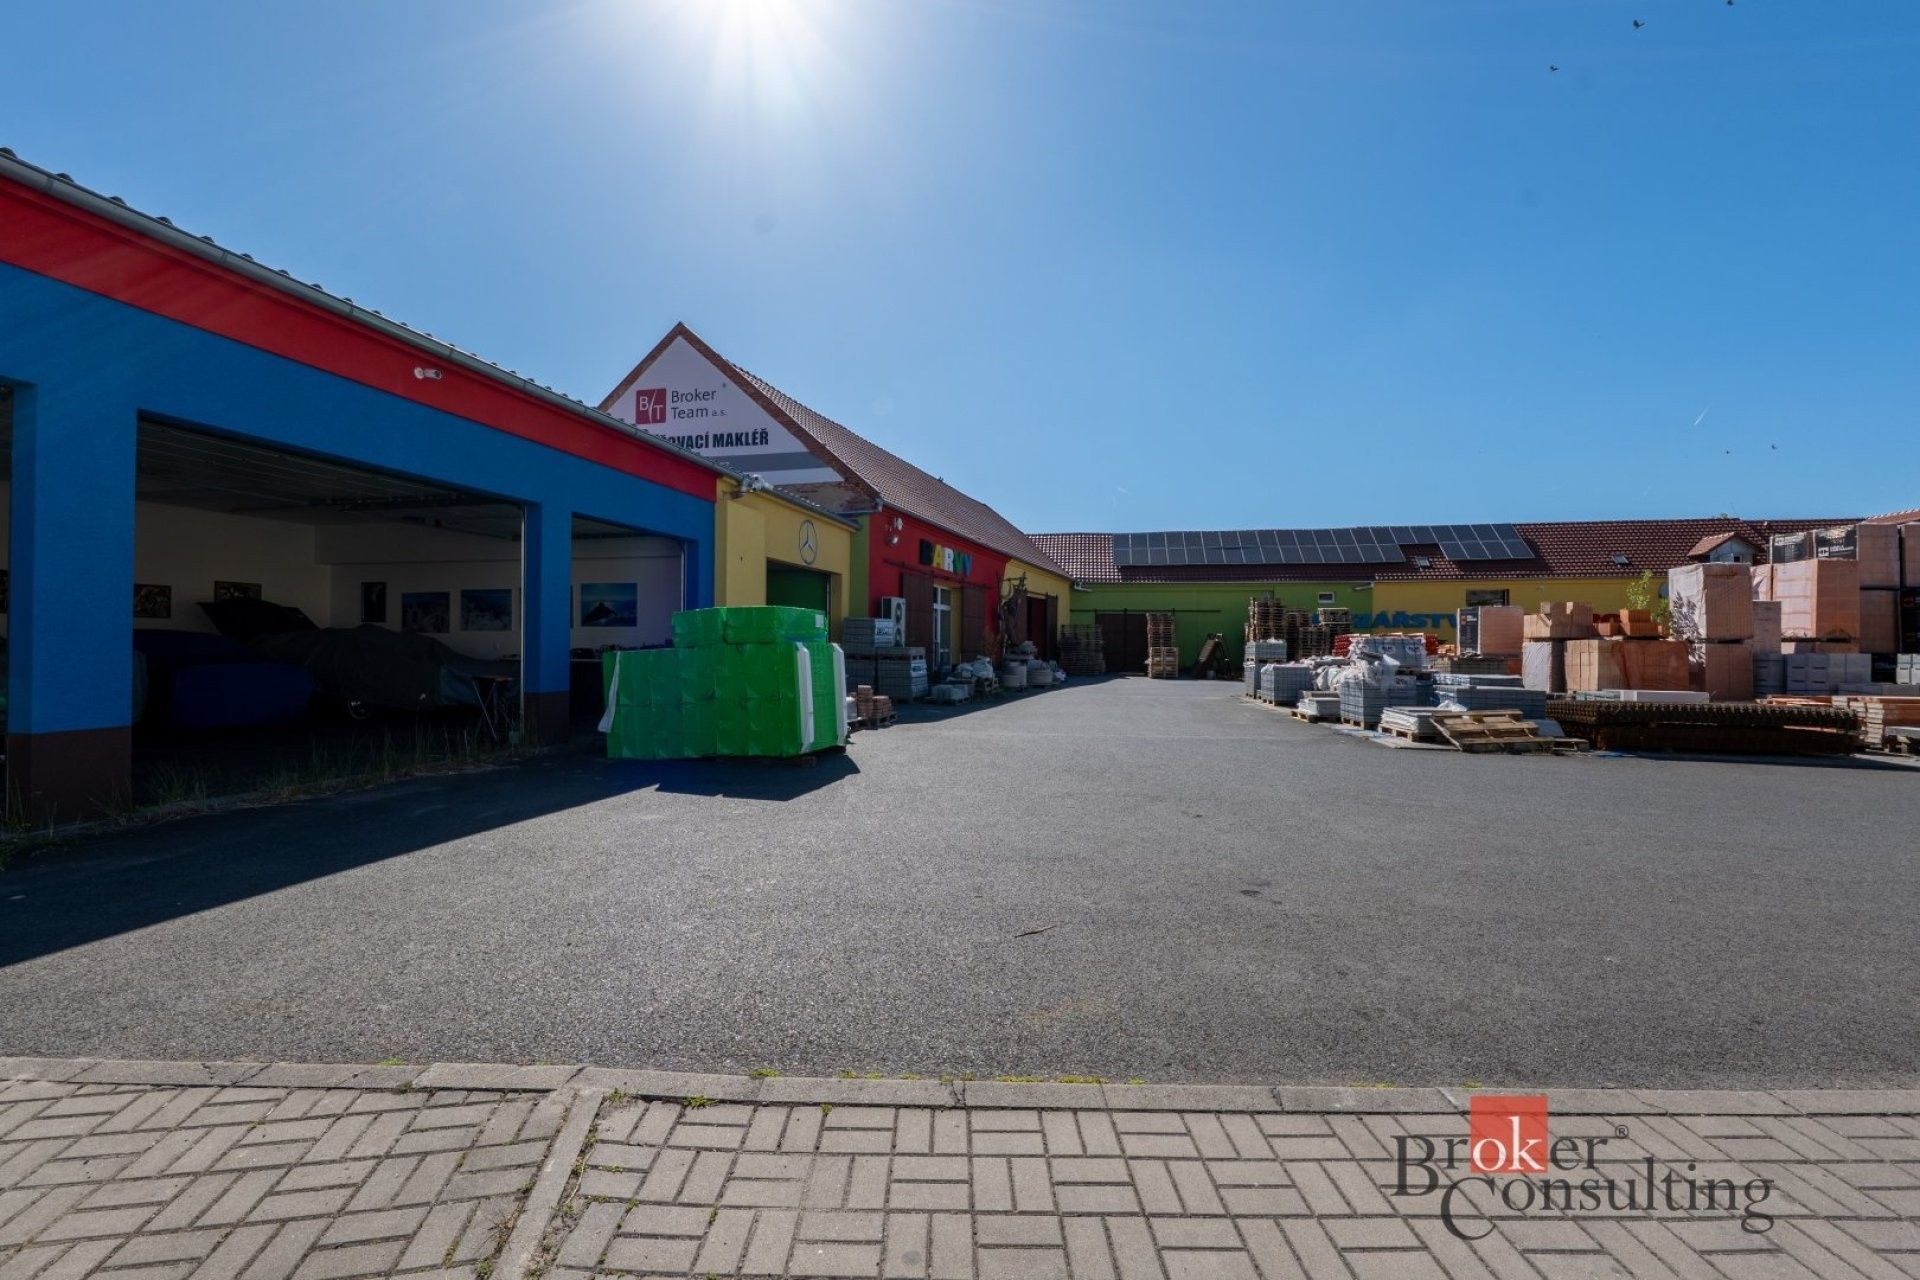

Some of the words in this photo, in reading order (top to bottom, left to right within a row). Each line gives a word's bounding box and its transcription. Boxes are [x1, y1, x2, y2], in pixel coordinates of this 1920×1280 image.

[671, 388, 717, 403] Broker
[671, 406, 709, 419] Team
[712, 427, 769, 448] MAKLÉŘ
